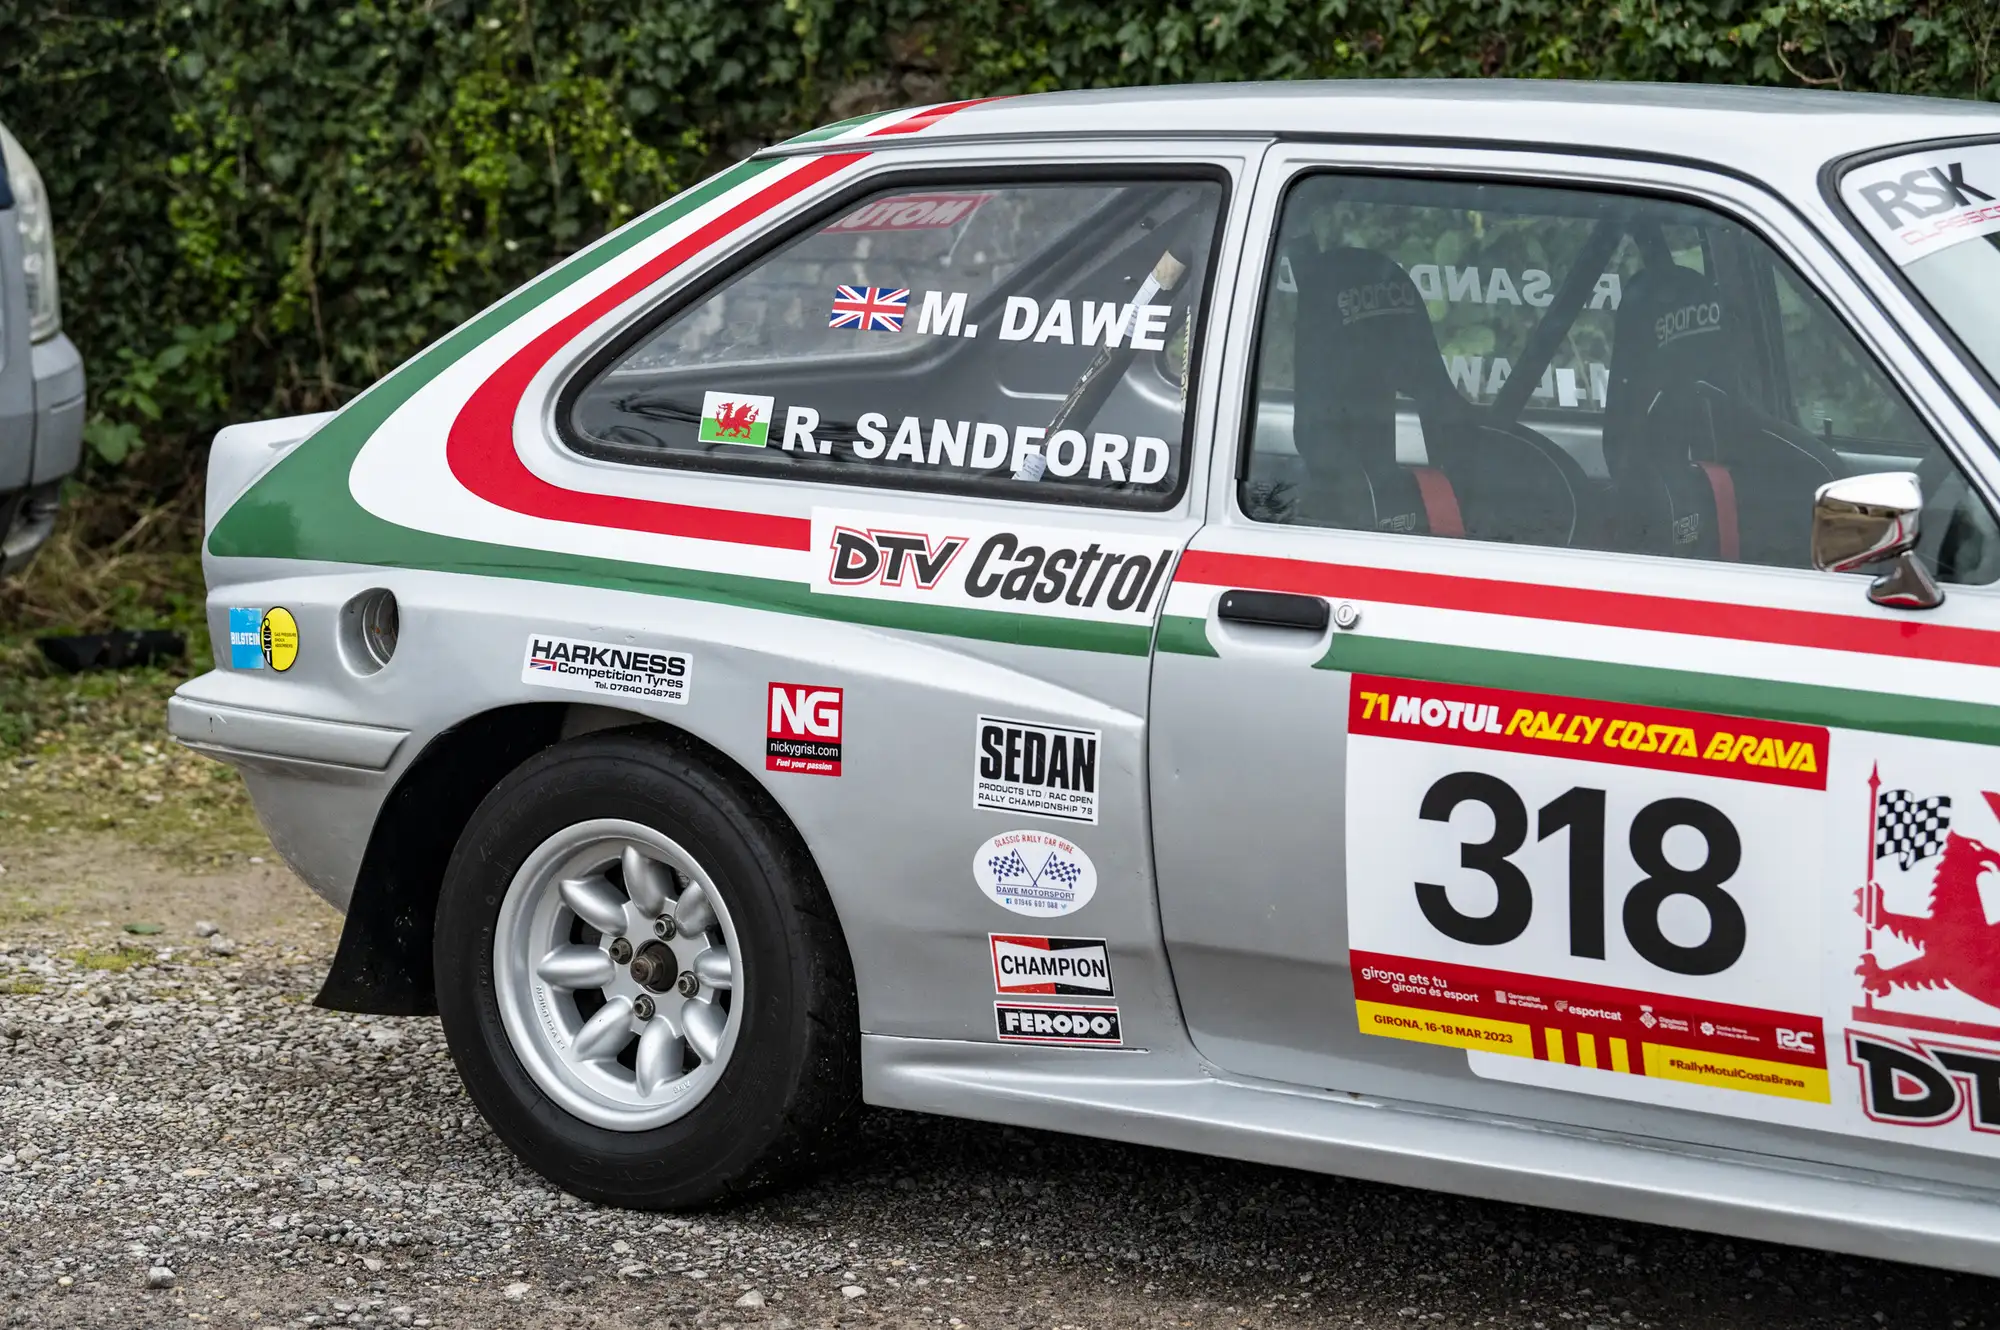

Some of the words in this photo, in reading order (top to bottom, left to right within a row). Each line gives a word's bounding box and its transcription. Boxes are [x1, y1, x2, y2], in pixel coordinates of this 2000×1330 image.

[1858, 161, 1997, 232] RSK
[916, 290, 979, 339] M.
[999, 296, 1171, 352] DAWE
[1655, 302, 1720, 346] sparco
[782, 406, 833, 455] R.
[852, 411, 1170, 484] SANDFORD
[829, 526, 969, 590] DTV
[963, 532, 1173, 613] Castrol
[230, 632, 261, 646] BILSTEIN
[531, 639, 686, 677] HARKNESS
[558, 662, 642, 684] Competition
[645, 673, 684, 688] Tyres
[594, 681, 609, 690] Tel.
[610, 683, 642, 694] 07840
[643, 687, 682, 699] 048725
[771, 687, 840, 738] NG
[1359, 692, 1390, 721] 71
[1390, 696, 1502, 734] MOTUL
[770, 741, 839, 757] nickygrist.com
[1504, 708, 1603, 746] RALLY
[1603, 721, 1698, 758] COSTA
[1702, 731, 1818, 773] BRAVA
[776, 758, 790, 767] Fuel
[791, 761, 806, 769] your
[806, 762, 832, 771] passion
[980, 725, 1097, 793] SEDAN
[978, 792, 1006, 803] RALLY
[1008, 796, 1078, 813] CHAMPIONSHIP
[979, 782, 1025, 796] PRODUCTS
[1026, 789, 1042, 798] LTD
[1048, 792, 1067, 802] RAC
[1069, 795, 1093, 805] OPEN
[994, 834, 1021, 849] CLASSIC
[1021, 834, 1041, 844] RALLY
[1043, 836, 1057, 847] CAR
[1058, 841, 1074, 855] HIRE
[1413, 771, 1747, 977] 318
[996, 885, 1020, 895] DAWE
[1020, 887, 1075, 900] MOTORSPORT
[1001, 955, 1106, 978] CHAMPION
[1361, 966, 1405, 982] girona
[1408, 974, 1430, 987] ets
[1432, 976, 1447, 989] tu
[1392, 982, 1426, 995] girona
[1428, 985, 1442, 997] és
[1443, 988, 1479, 1003] esport
[1005, 1011, 1112, 1035] FERODO
[1568, 1005, 1622, 1022] esportcat
[1373, 1014, 1423, 1032] GIRONA,
[1424, 1021, 1453, 1035] 16-18
[1455, 1026, 1482, 1039] MAR
[1483, 1030, 1513, 1044] 2023
[1668, 1059, 1805, 1088] #RallyMotulCostaBrava
